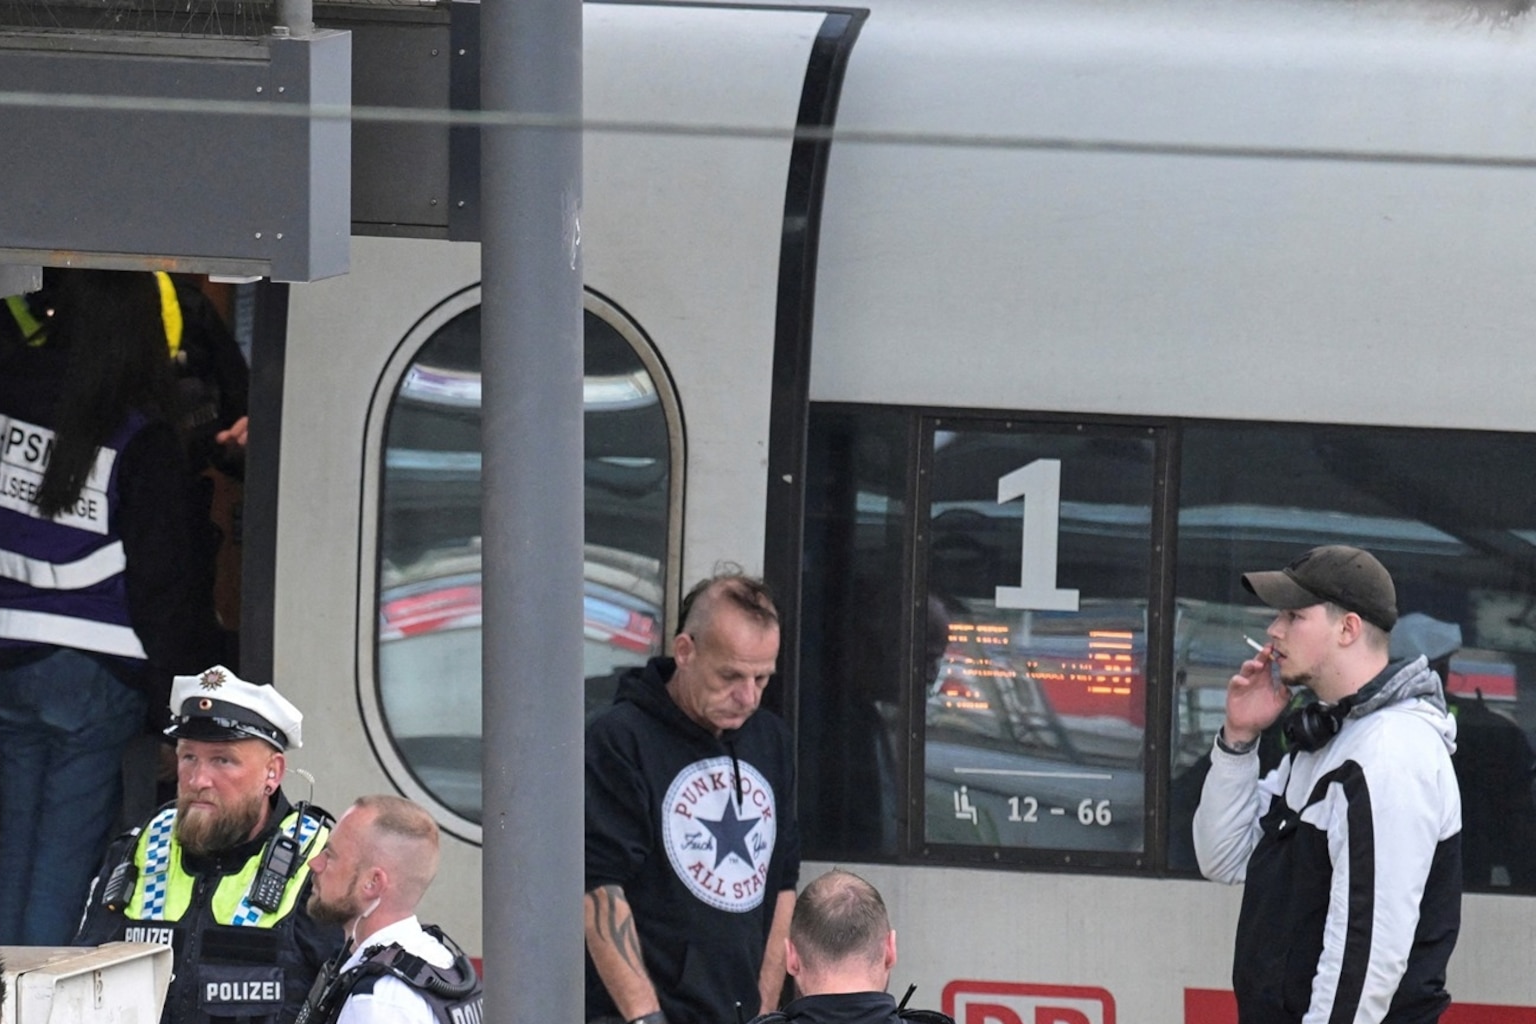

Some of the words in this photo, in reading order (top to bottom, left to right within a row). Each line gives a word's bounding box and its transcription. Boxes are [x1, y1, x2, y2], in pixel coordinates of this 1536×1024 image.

[995, 458, 1080, 612] 1
[675, 772, 727, 820] PUNK
[1007, 796, 1038, 823] 12
[1076, 798, 1112, 826] 66
[689, 862, 726, 897] ALL
[125, 927, 174, 946] POLIZEI
[206, 981, 281, 1001] POLIZEI
